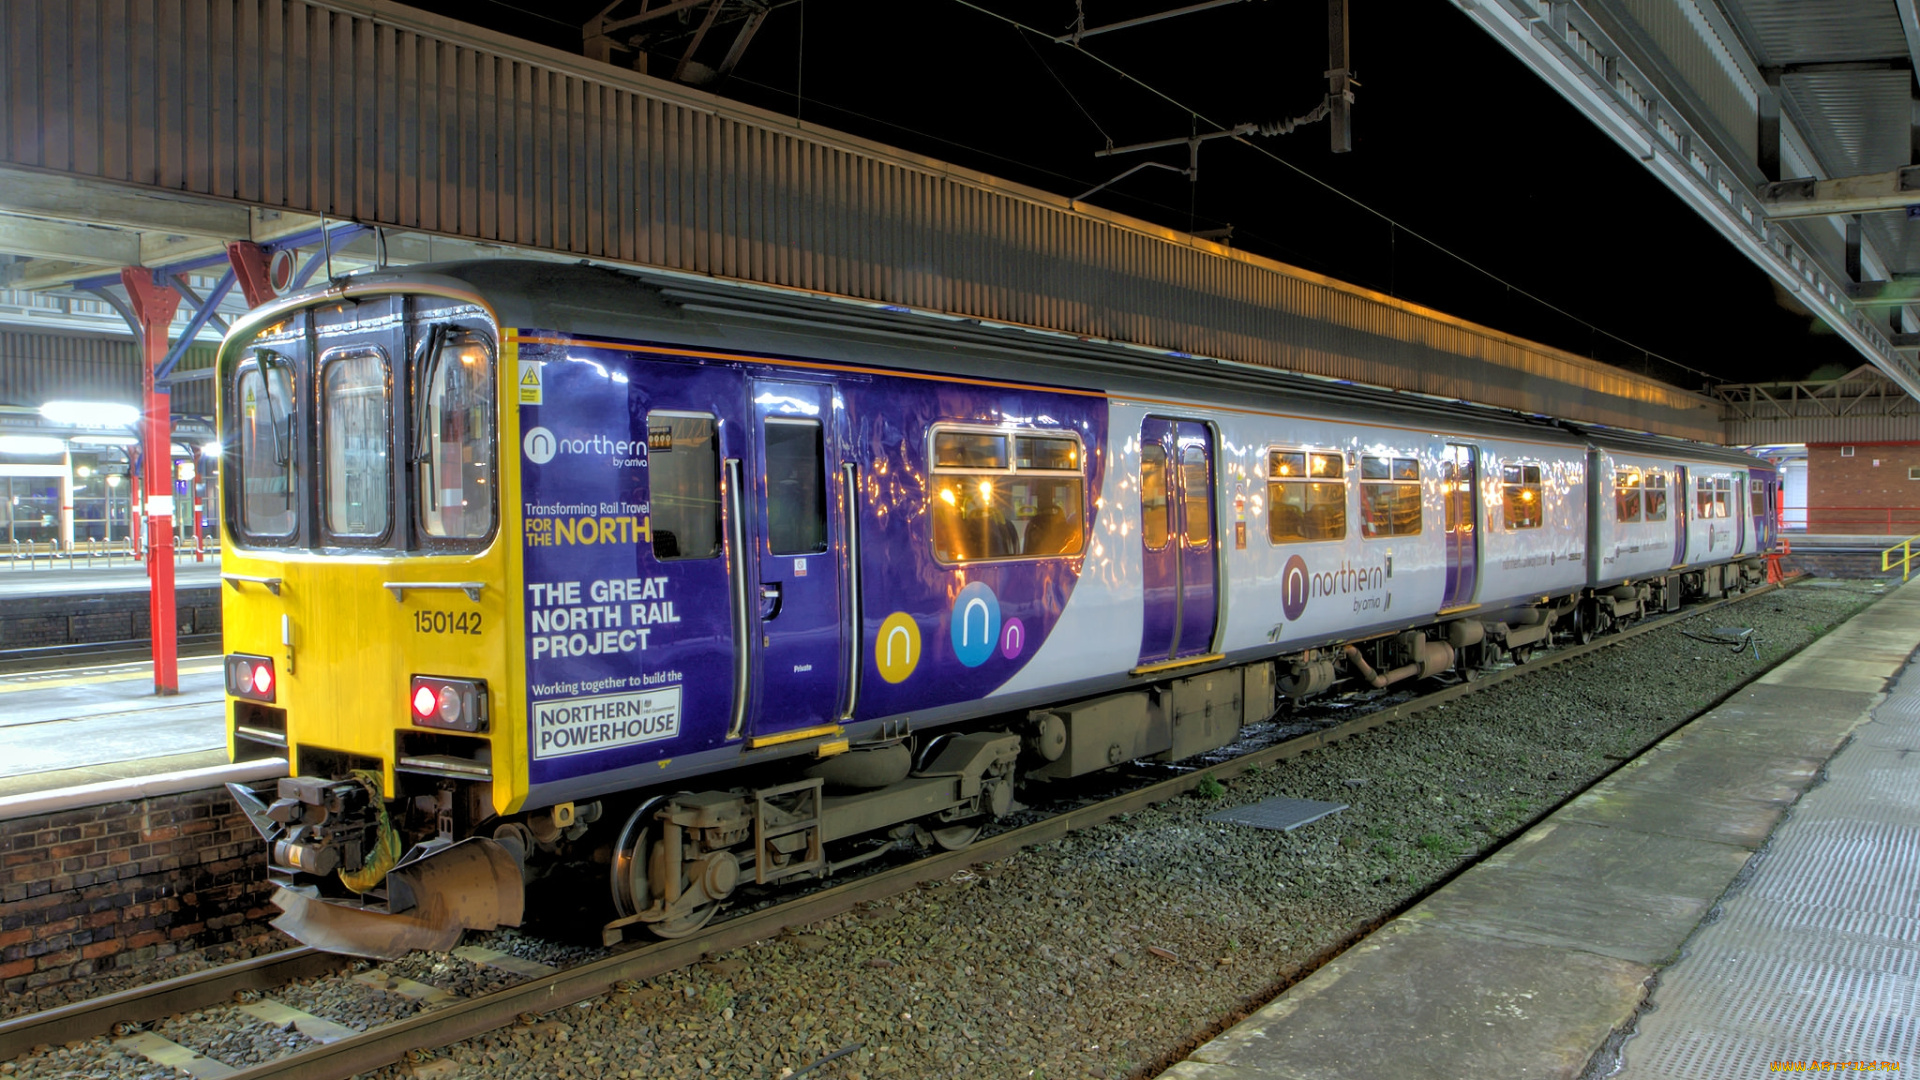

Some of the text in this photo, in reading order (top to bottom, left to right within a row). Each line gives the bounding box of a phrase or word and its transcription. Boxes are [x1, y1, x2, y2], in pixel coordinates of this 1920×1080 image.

[560, 434, 647, 456] northern
[613, 457, 647, 468] by arriva
[525, 502, 650, 517] Transforming Rail Travel
[525, 518, 552, 532] FOR
[555, 516, 651, 546] NORTH
[526, 533, 552, 547] THE
[528, 576, 668, 606] THE GREAT
[1312, 560, 1382, 598] northern
[532, 601, 681, 633] NORTH RAIL
[1353, 597, 1380, 614] by arriva
[414, 610, 482, 635] 150142
[532, 628, 651, 660] PROJECT
[794, 664, 812, 673] Private
[532, 670, 682, 696] Working together to build the
[541, 699, 641, 727] NORTHERN
[541, 713, 675, 750] POWERHOUSE
